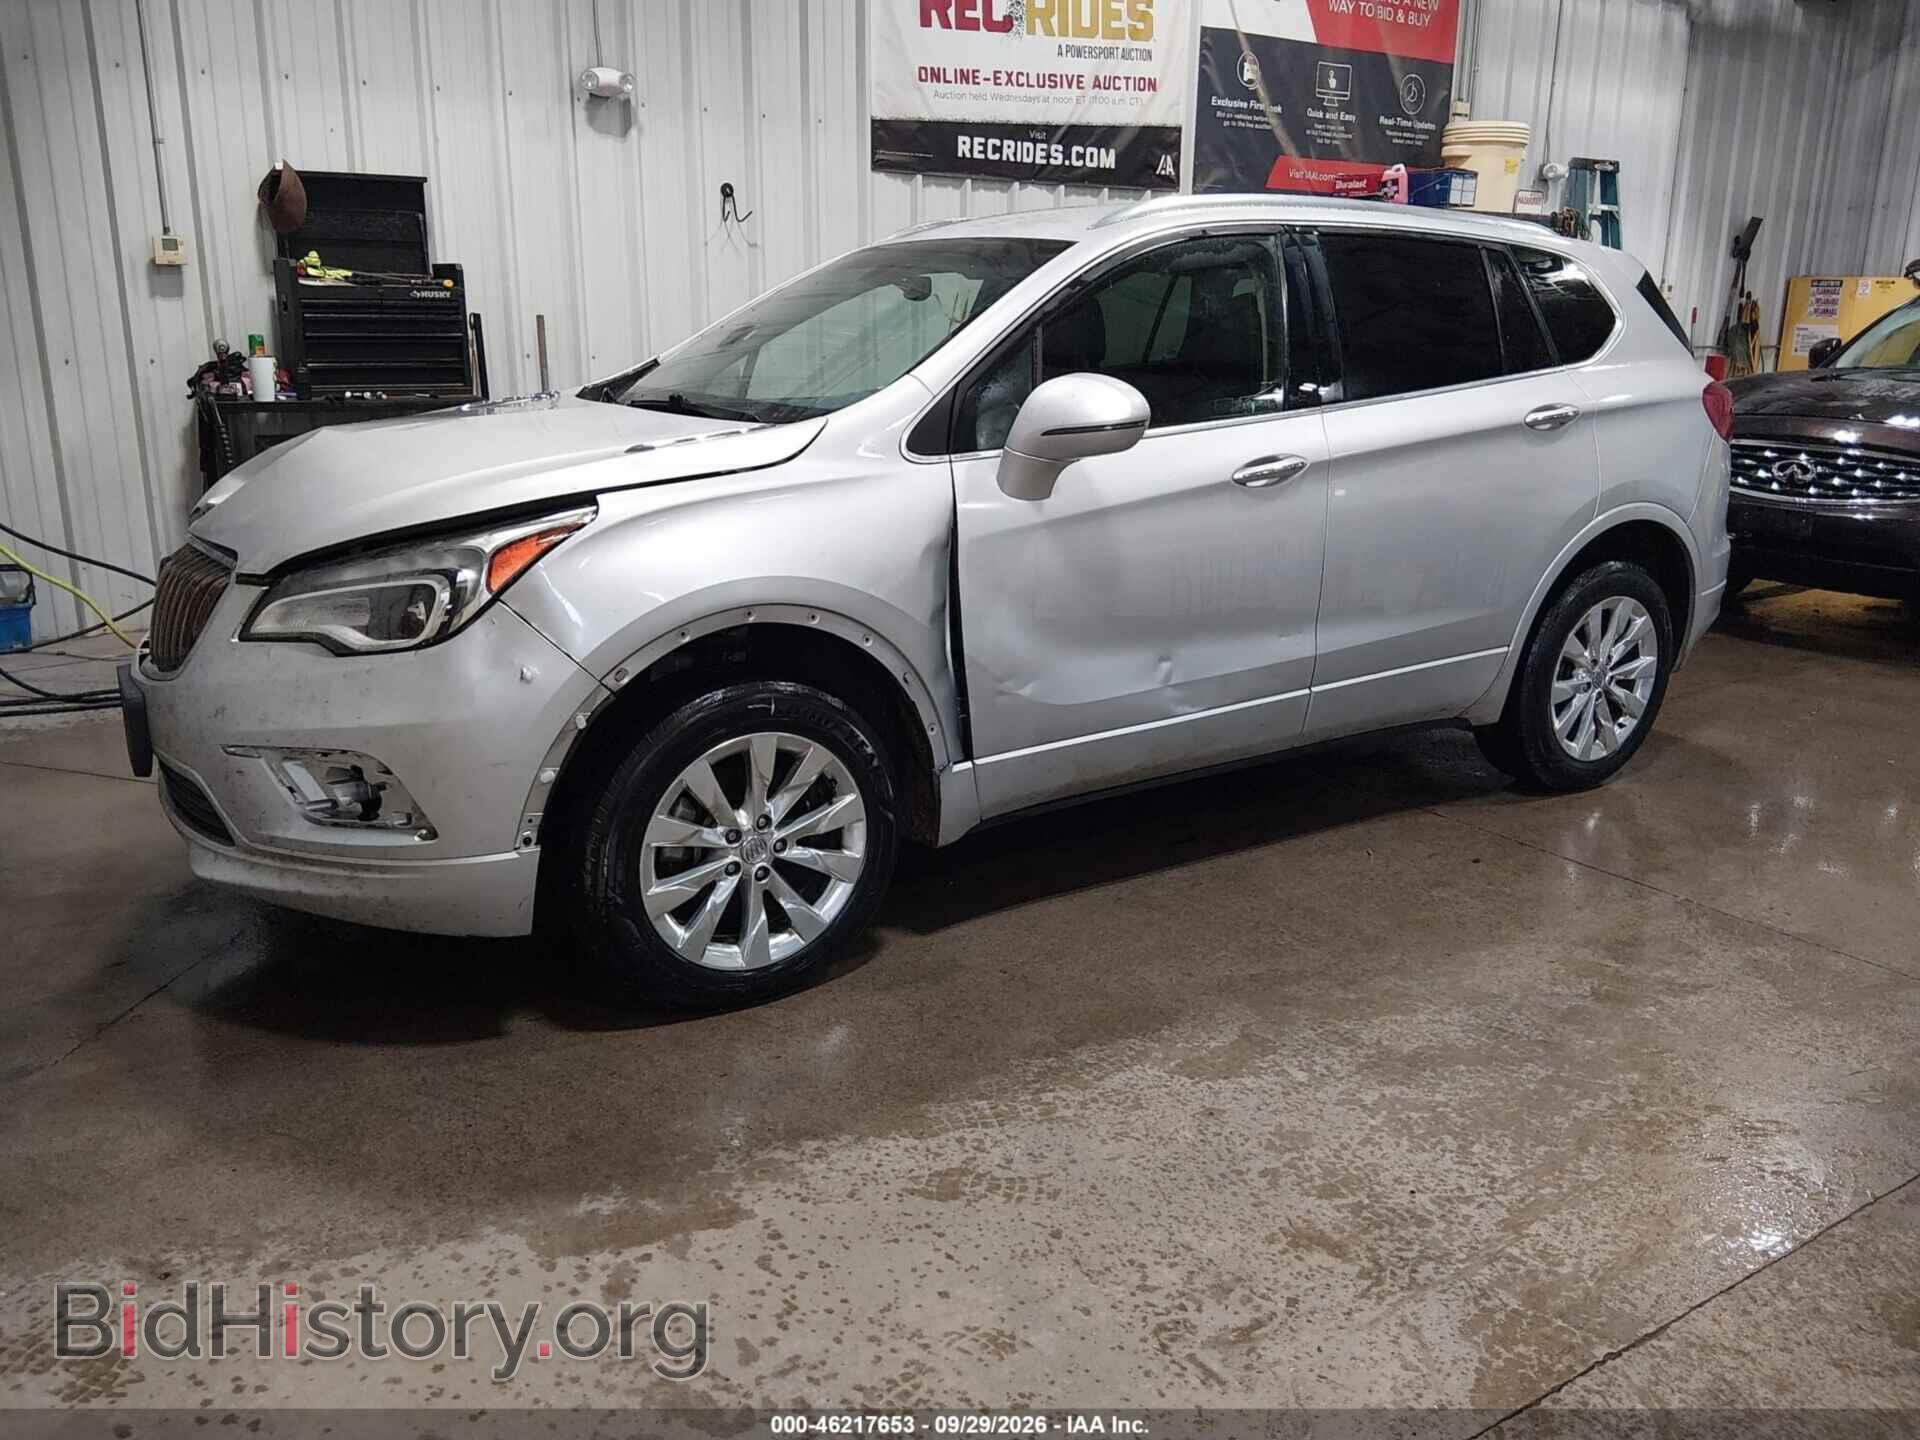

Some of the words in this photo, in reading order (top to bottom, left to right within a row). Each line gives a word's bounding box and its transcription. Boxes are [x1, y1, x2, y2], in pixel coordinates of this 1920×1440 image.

[1328, 0, 1355, 14] WAY
[1359, 2, 1375, 17] TO
[1377, 6, 1394, 21] BID
[1396, 9, 1405, 23] &
[1408, 11, 1431, 27] BUY
[1057, 44, 1063, 57] A
[1065, 45, 1119, 60] POWERSPORT
[1121, 47, 1152, 62] AUCTION
[918, 66, 1085, 90] ONLINE-EXCLUSIVE
[1092, 74, 1158, 92] AUCTION
[933, 89, 967, 100] Auction
[1211, 96, 1248, 109] Exclusive
[1307, 107, 1324, 119] Quick
[1325, 112, 1338, 120] and
[1340, 112, 1356, 124] Easy
[1379, 116, 1412, 127] Real-Time
[1029, 129, 1047, 140] Visit
[957, 136, 1116, 169] RECRIDES.COM
